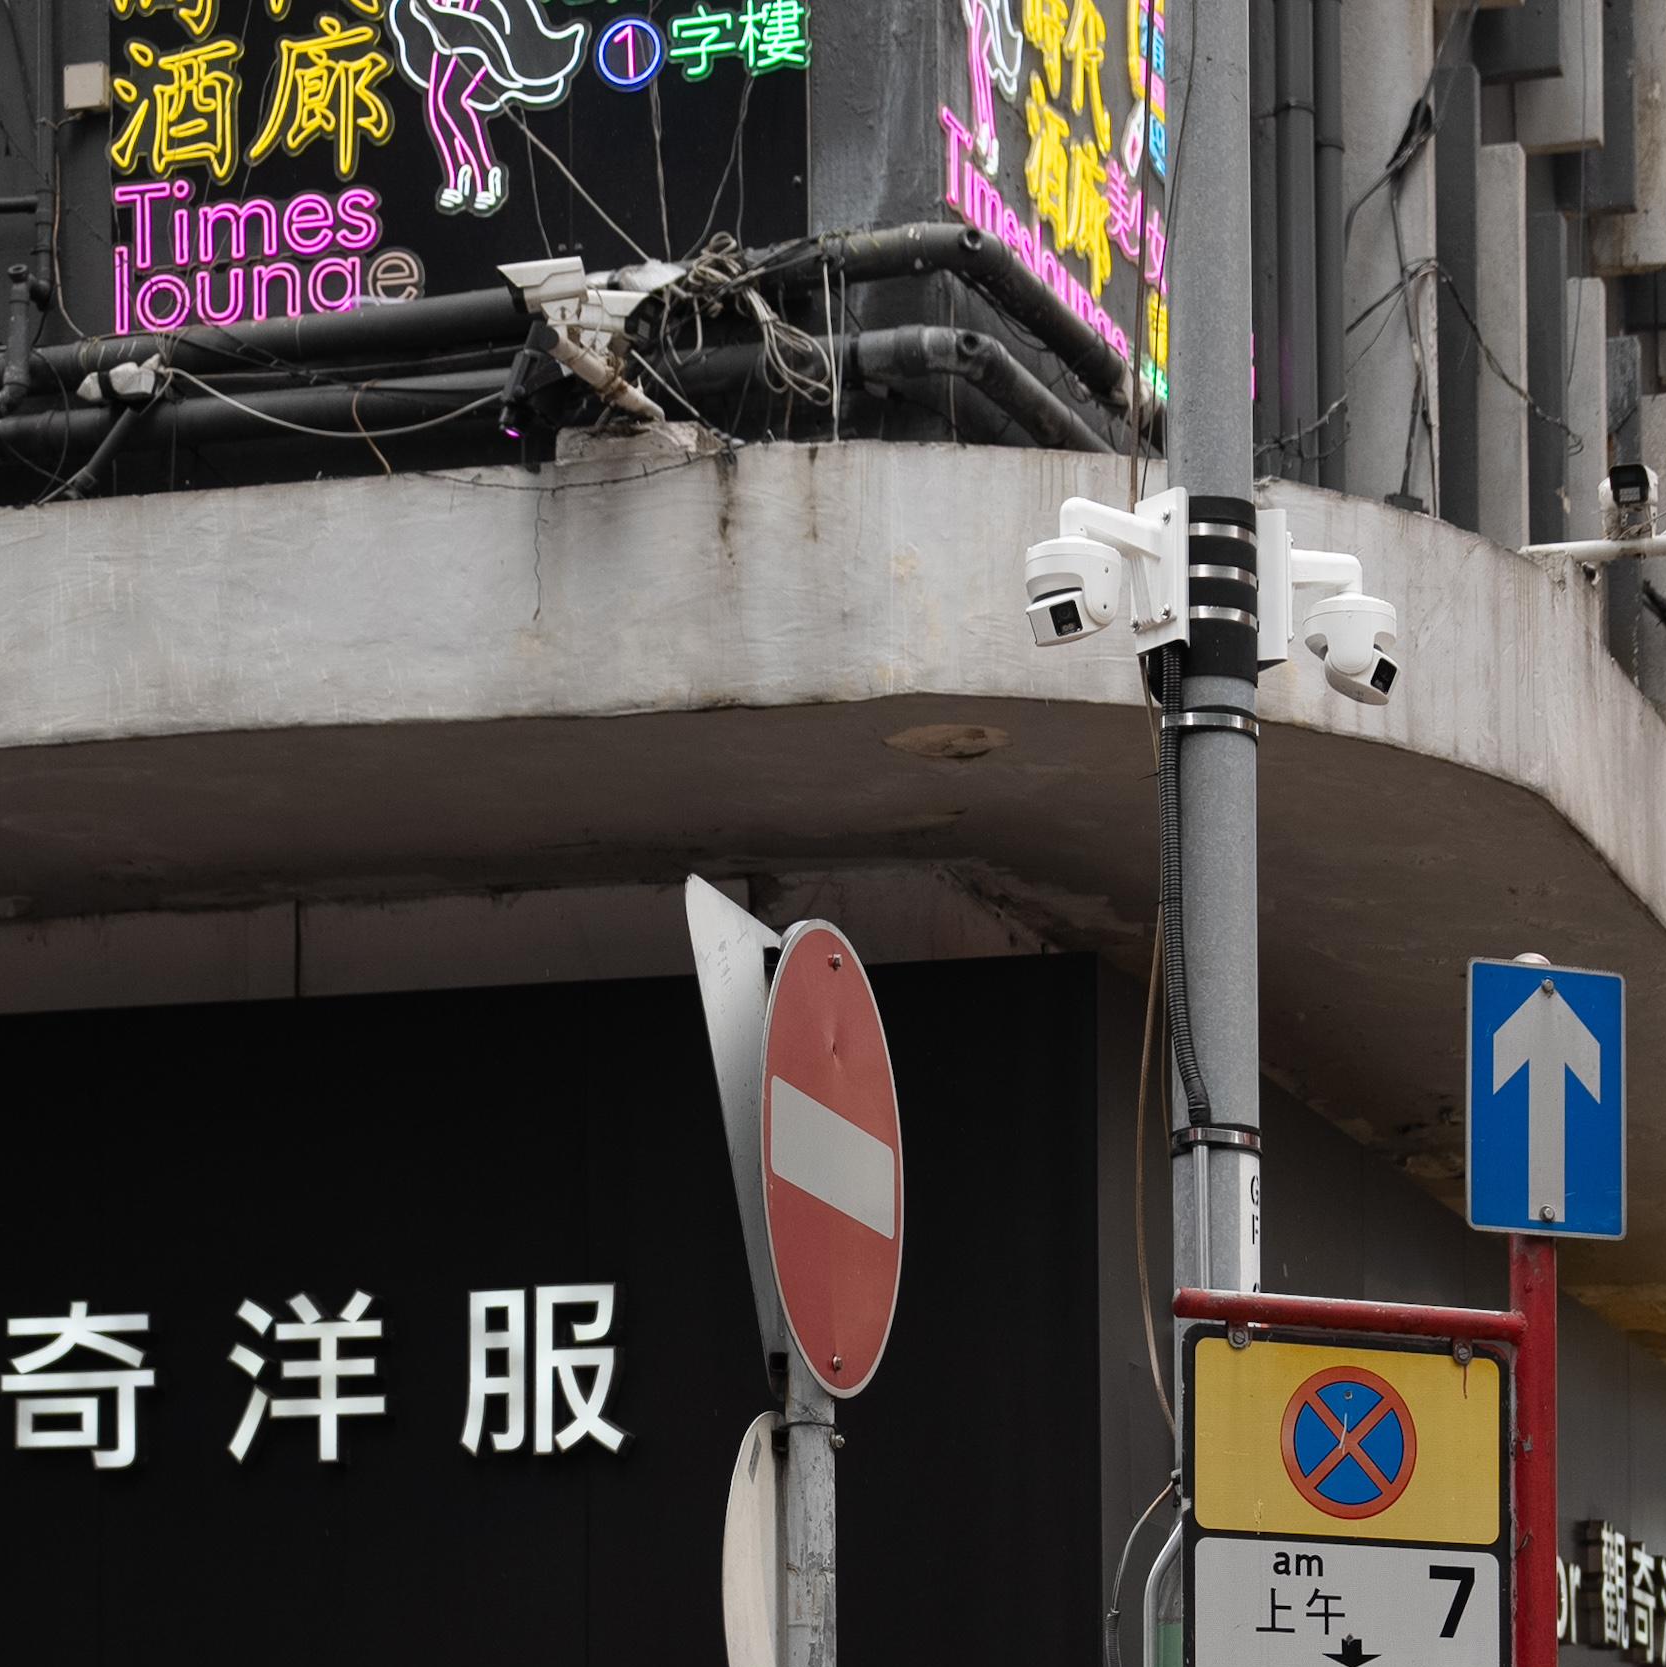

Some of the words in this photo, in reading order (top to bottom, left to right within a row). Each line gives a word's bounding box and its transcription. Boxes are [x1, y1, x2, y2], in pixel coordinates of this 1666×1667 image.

[111, 40, 389, 178] 酒廊
[114, 180, 377, 269] Times
[1273, 1551, 1325, 1578] am
[1256, 1588, 1346, 1635] 上午
[1429, 1565, 1476, 1639] 7
